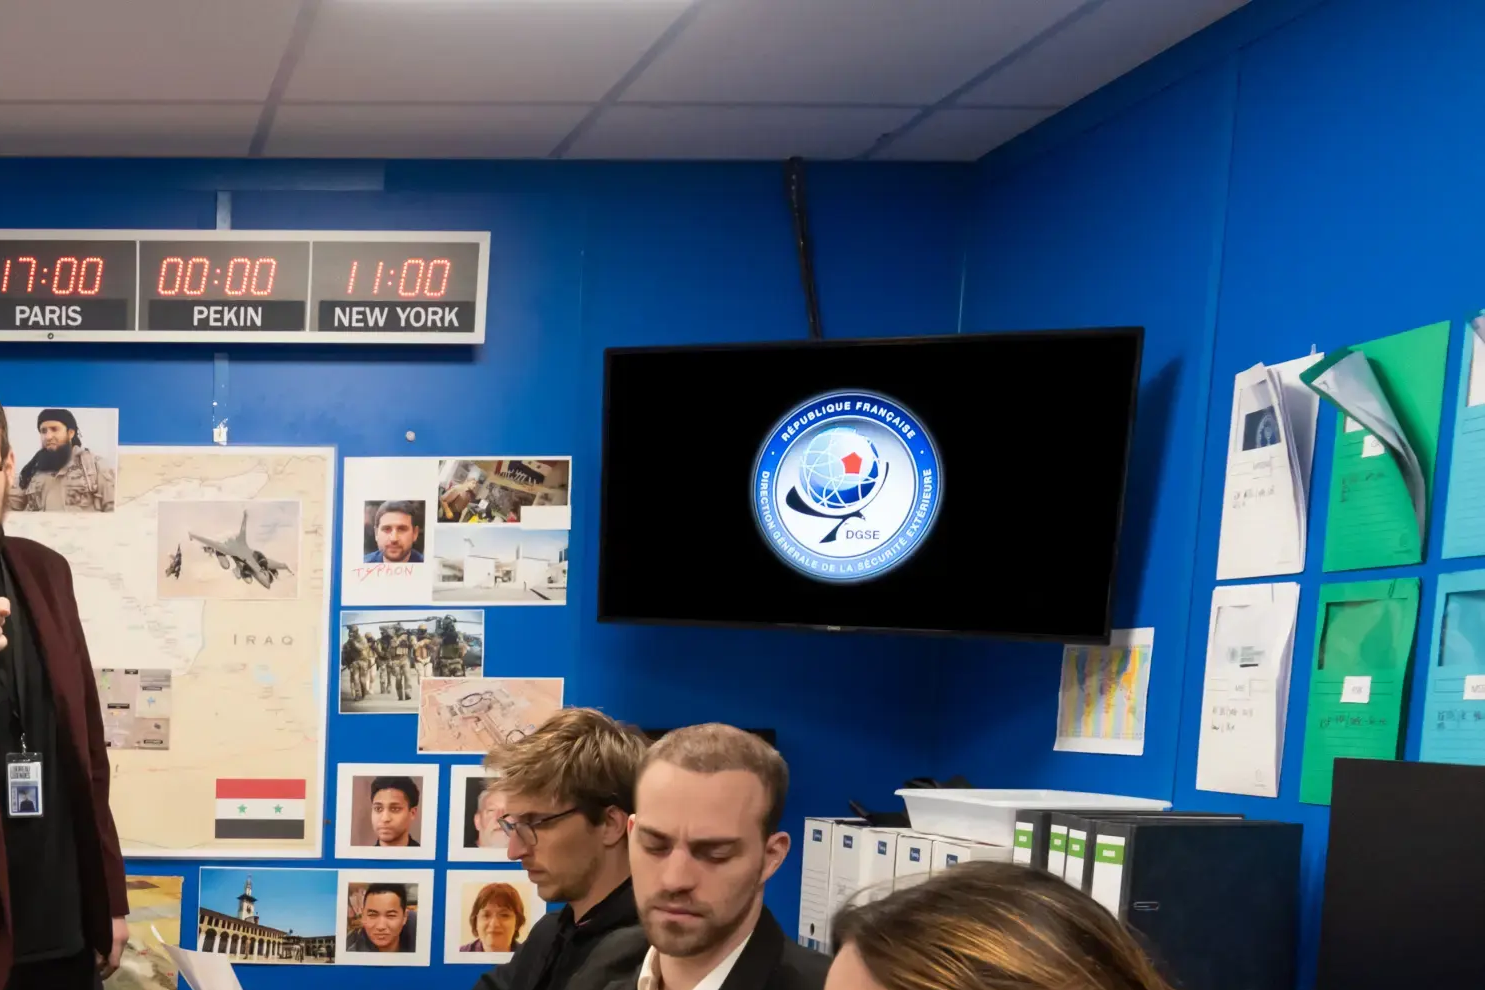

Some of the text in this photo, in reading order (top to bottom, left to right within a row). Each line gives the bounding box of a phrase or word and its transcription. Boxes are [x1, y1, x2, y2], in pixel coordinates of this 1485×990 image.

[0, 257, 104, 296] 17:00
[158, 257, 277, 296] 00:00
[346, 258, 451, 298] 11:00
[15, 305, 82, 326] PARIS
[193, 306, 262, 327] PEKIN
[333, 306, 459, 327] NEW YORK
[781, 401, 916, 441] RÉPUBLIQUE FRANÇAISE
[760, 468, 933, 573] DIRECTION GÉNÉRALE DE LA SÉCURITÉ EXTÉRIEURE
[845, 530, 880, 540] DGSE
[233, 633, 294, 646] IRAQ
